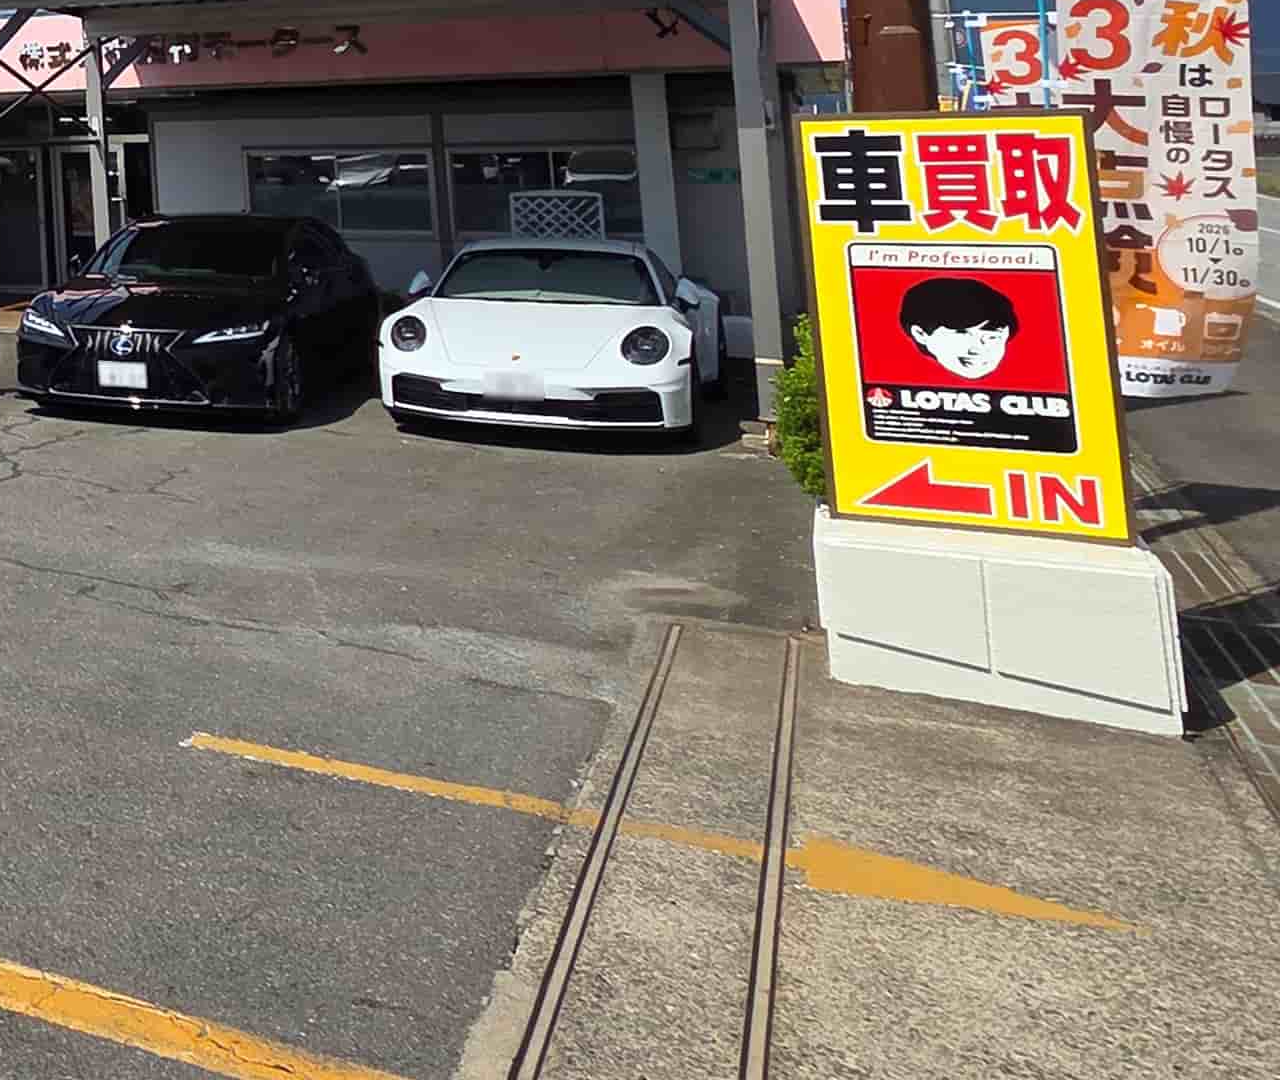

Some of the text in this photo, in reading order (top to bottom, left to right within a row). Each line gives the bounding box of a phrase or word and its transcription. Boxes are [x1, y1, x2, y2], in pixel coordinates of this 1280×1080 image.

[1152, 0, 1236, 87] 秋は
[1159, 94, 1196, 165] 自慢の
[1198, 96, 1238, 201] ロータス
[813, 129, 1083, 233] 車買取
[868, 249, 1040, 265] I'm Professional.
[1140, 338, 1187, 353] オイル
[900, 389, 1072, 418] LOTAS CLUB
[1007, 472, 1102, 526] IN
